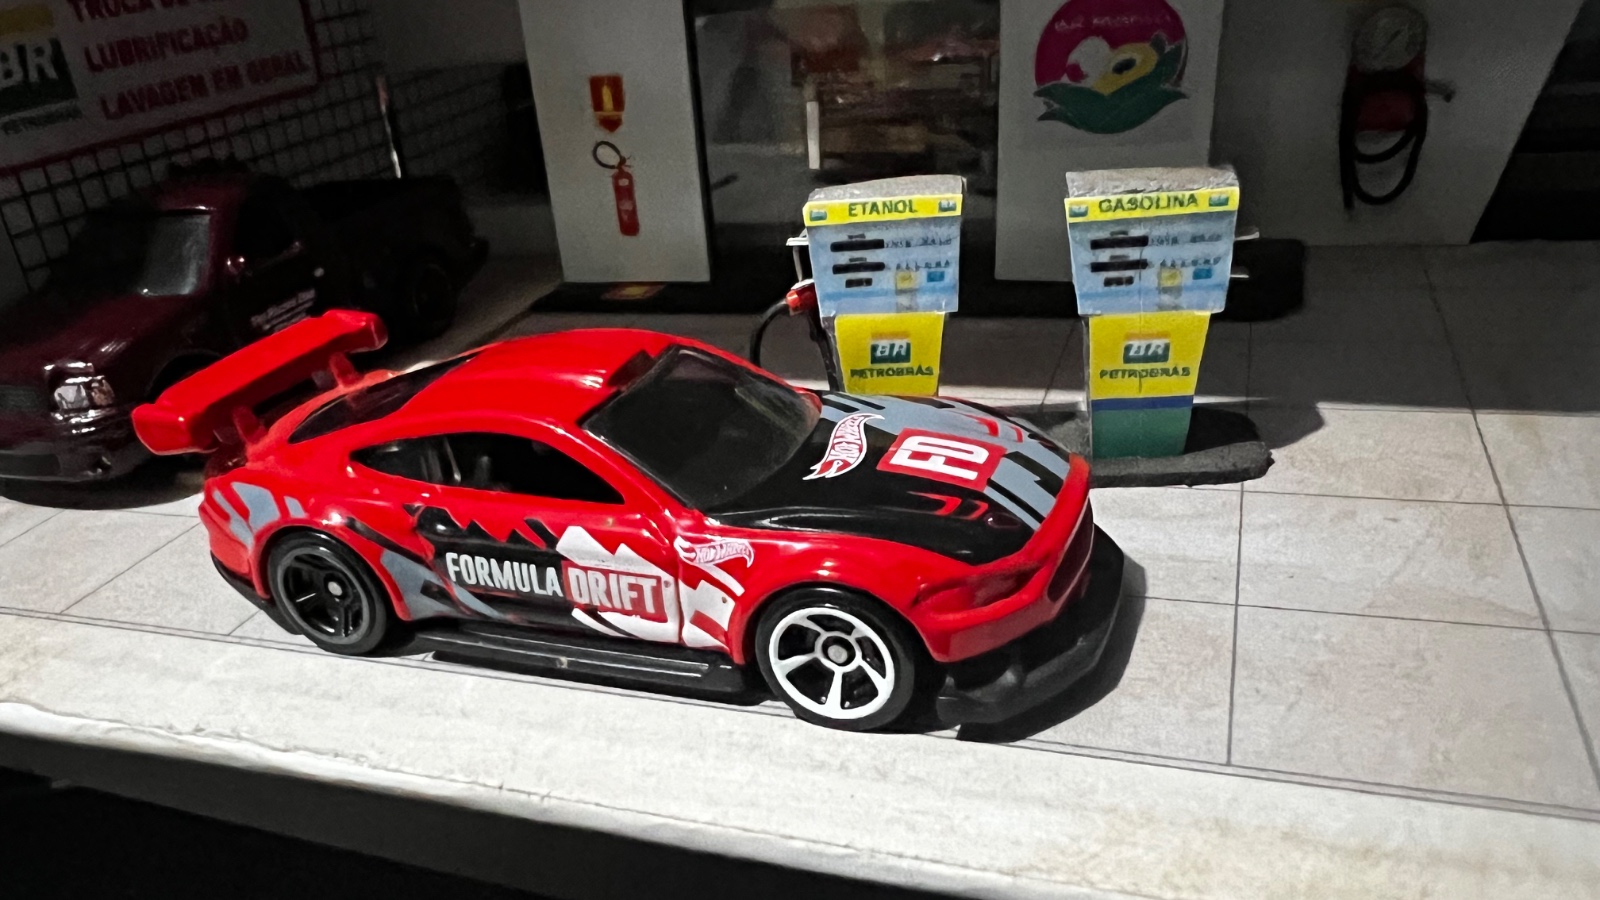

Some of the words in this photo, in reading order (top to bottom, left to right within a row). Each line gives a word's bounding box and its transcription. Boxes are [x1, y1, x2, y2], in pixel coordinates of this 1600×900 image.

[0, 42, 59, 89] BR
[84, 15, 249, 73] LUBRIFICAÇÃO
[101, 73, 209, 120] LAVAGEM
[211, 65, 243, 91] EM
[247, 50, 309, 83] GERAL
[848, 199, 918, 217] ETANOL
[1099, 193, 1199, 213] GASOLINA
[873, 341, 907, 357] BR
[1129, 341, 1165, 356] BR
[889, 435, 990, 481] FD
[445, 551, 564, 597] FORMULA
[567, 566, 661, 614] DRIFT
